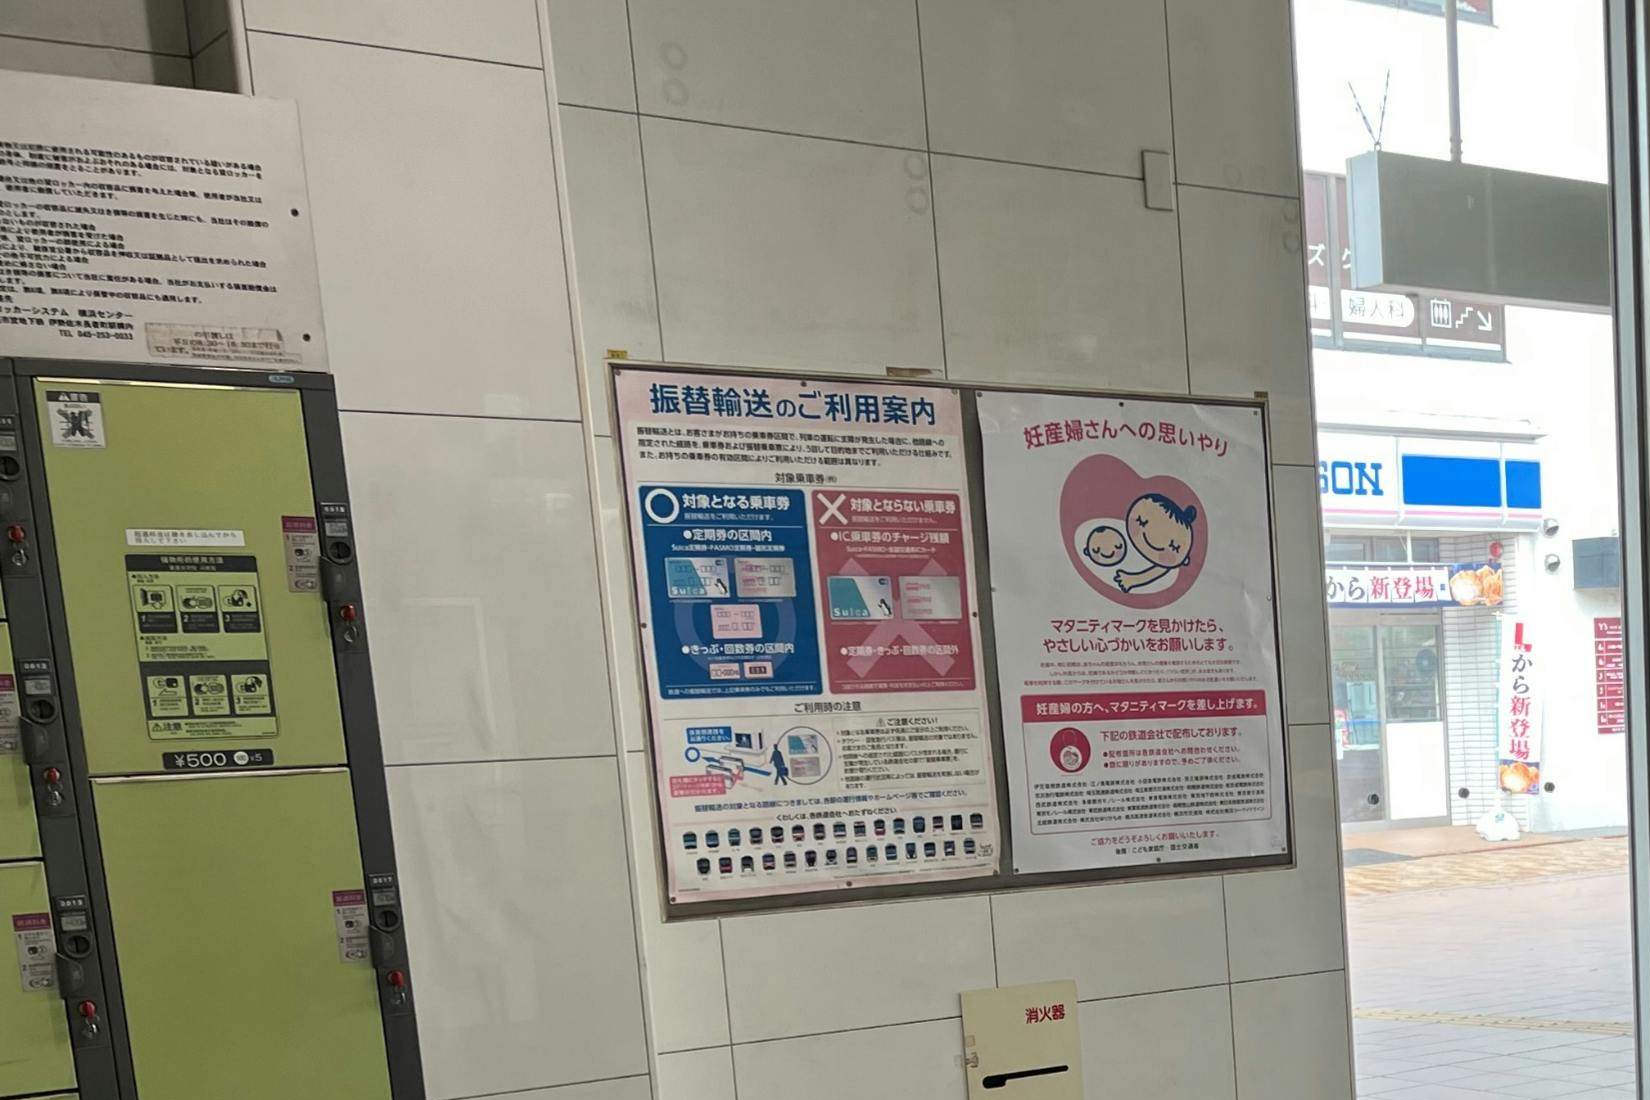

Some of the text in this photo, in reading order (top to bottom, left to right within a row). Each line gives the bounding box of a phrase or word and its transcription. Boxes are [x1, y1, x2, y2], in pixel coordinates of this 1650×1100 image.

[1349, 297, 1404, 318] 婦人科
[650, 383, 936, 425] 振替輸送のご利用案内
[1023, 419, 1228, 457] 妊産婦さんへの思いやり
[682, 494, 790, 510] 対象となる乗車券
[850, 499, 956, 514] 対象とならない乗車券
[692, 529, 772, 542] 定期券の区間内
[834, 607, 869, 617] Suica
[1051, 619, 1224, 634] マタニティマークを見かけたら、
[1043, 637, 1234, 653] やさしい心づかいをお願いします。
[794, 701, 862, 713] ご利用時の注意
[1036, 698, 1258, 716] 妊産婦の方へ、マタニティマークを差し上げます。
[1101, 727, 1242, 741] 下記の鉄道会社で配布しております。
[175, 753, 227, 768] ¥500
[1025, 1004, 1065, 1024] 消火器
